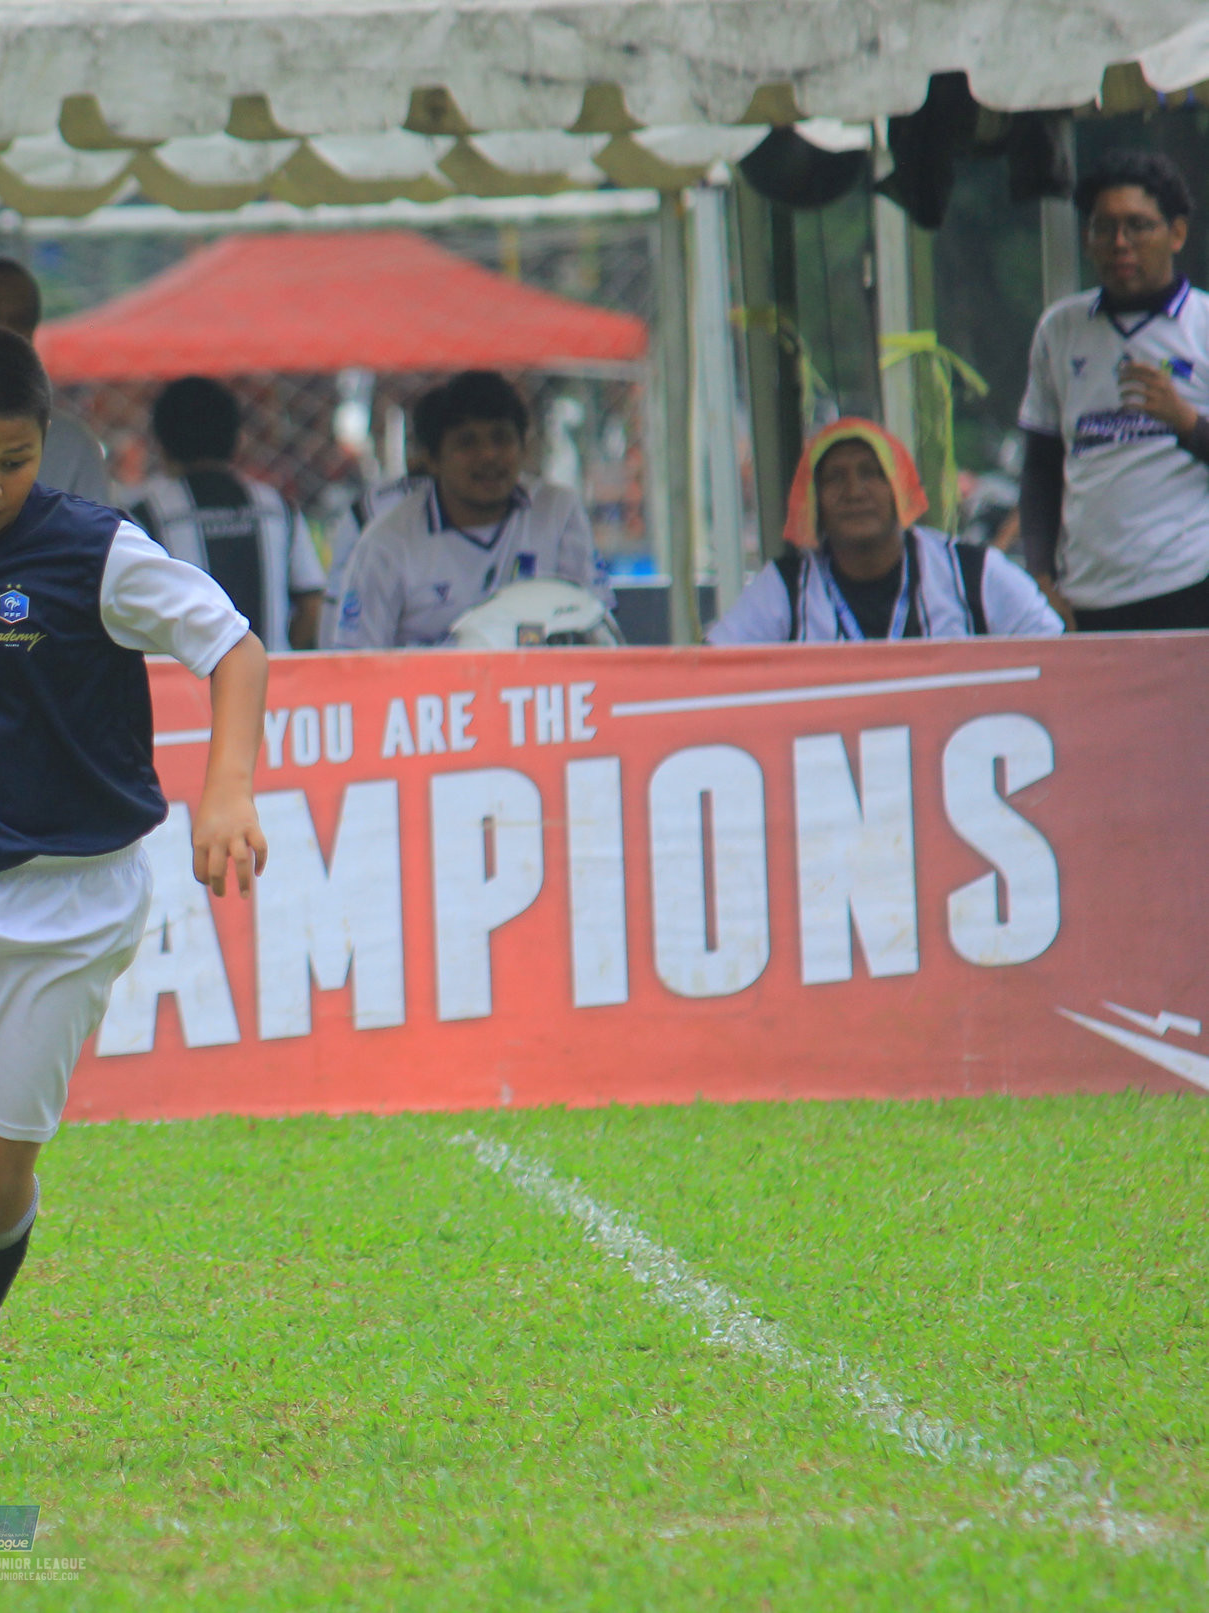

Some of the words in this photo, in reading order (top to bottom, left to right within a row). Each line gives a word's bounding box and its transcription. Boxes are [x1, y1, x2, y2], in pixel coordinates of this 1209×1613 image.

[3, 611, 23, 619] FFF
[263, 702, 354, 770] YOU
[381, 690, 479, 760] ARE
[498, 680, 599, 748] THE
